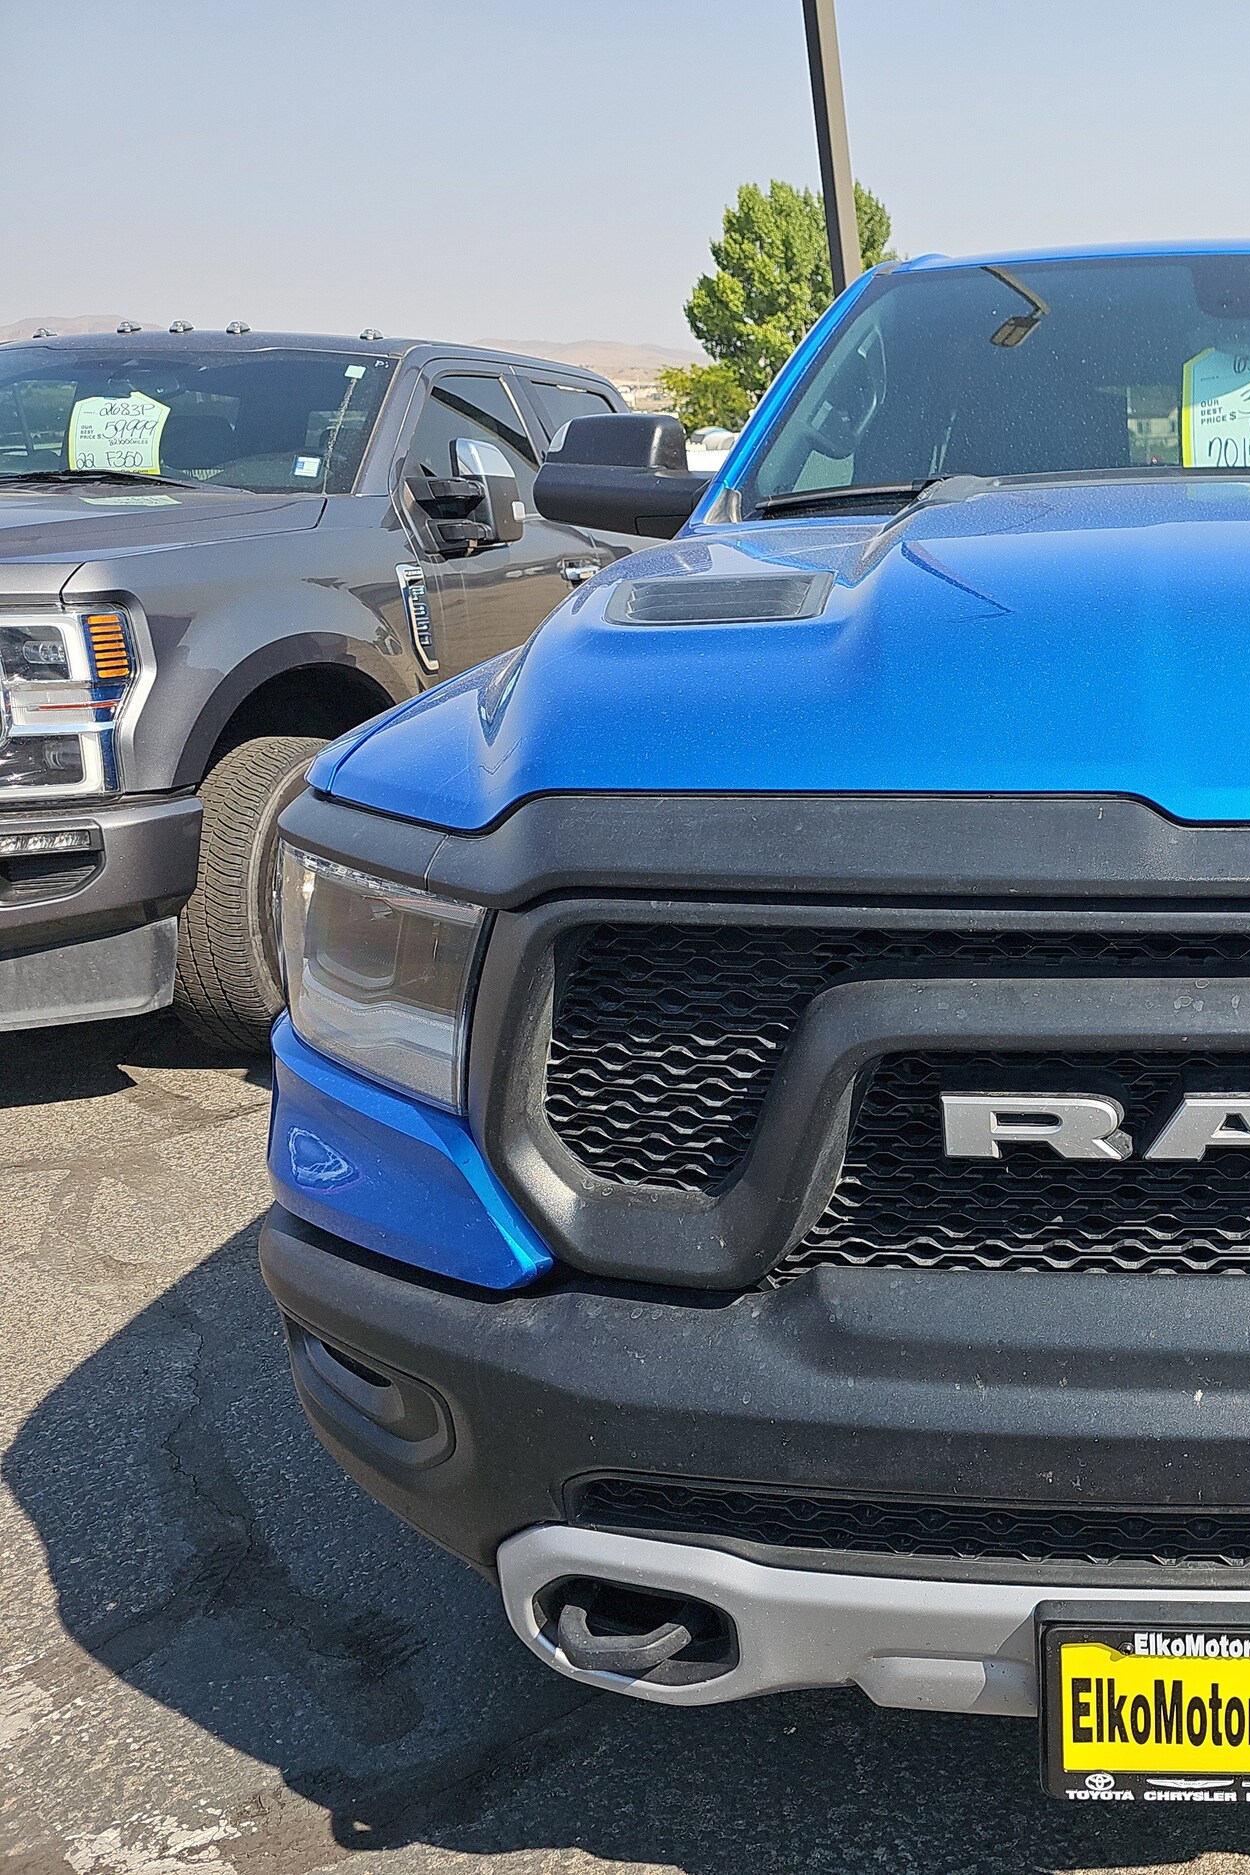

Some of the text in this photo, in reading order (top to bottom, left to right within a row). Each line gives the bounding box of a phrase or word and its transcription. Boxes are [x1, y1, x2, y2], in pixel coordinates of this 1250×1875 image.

[1200, 399, 1219, 408] OUR
[1201, 407, 1223, 416] BEST
[1201, 415, 1227, 425] PRICE
[102, 420, 159, 439] 59999
[1065, 1790, 1134, 1800] TOYOTA
[1144, 1790, 1237, 1801] CHRYSLER
